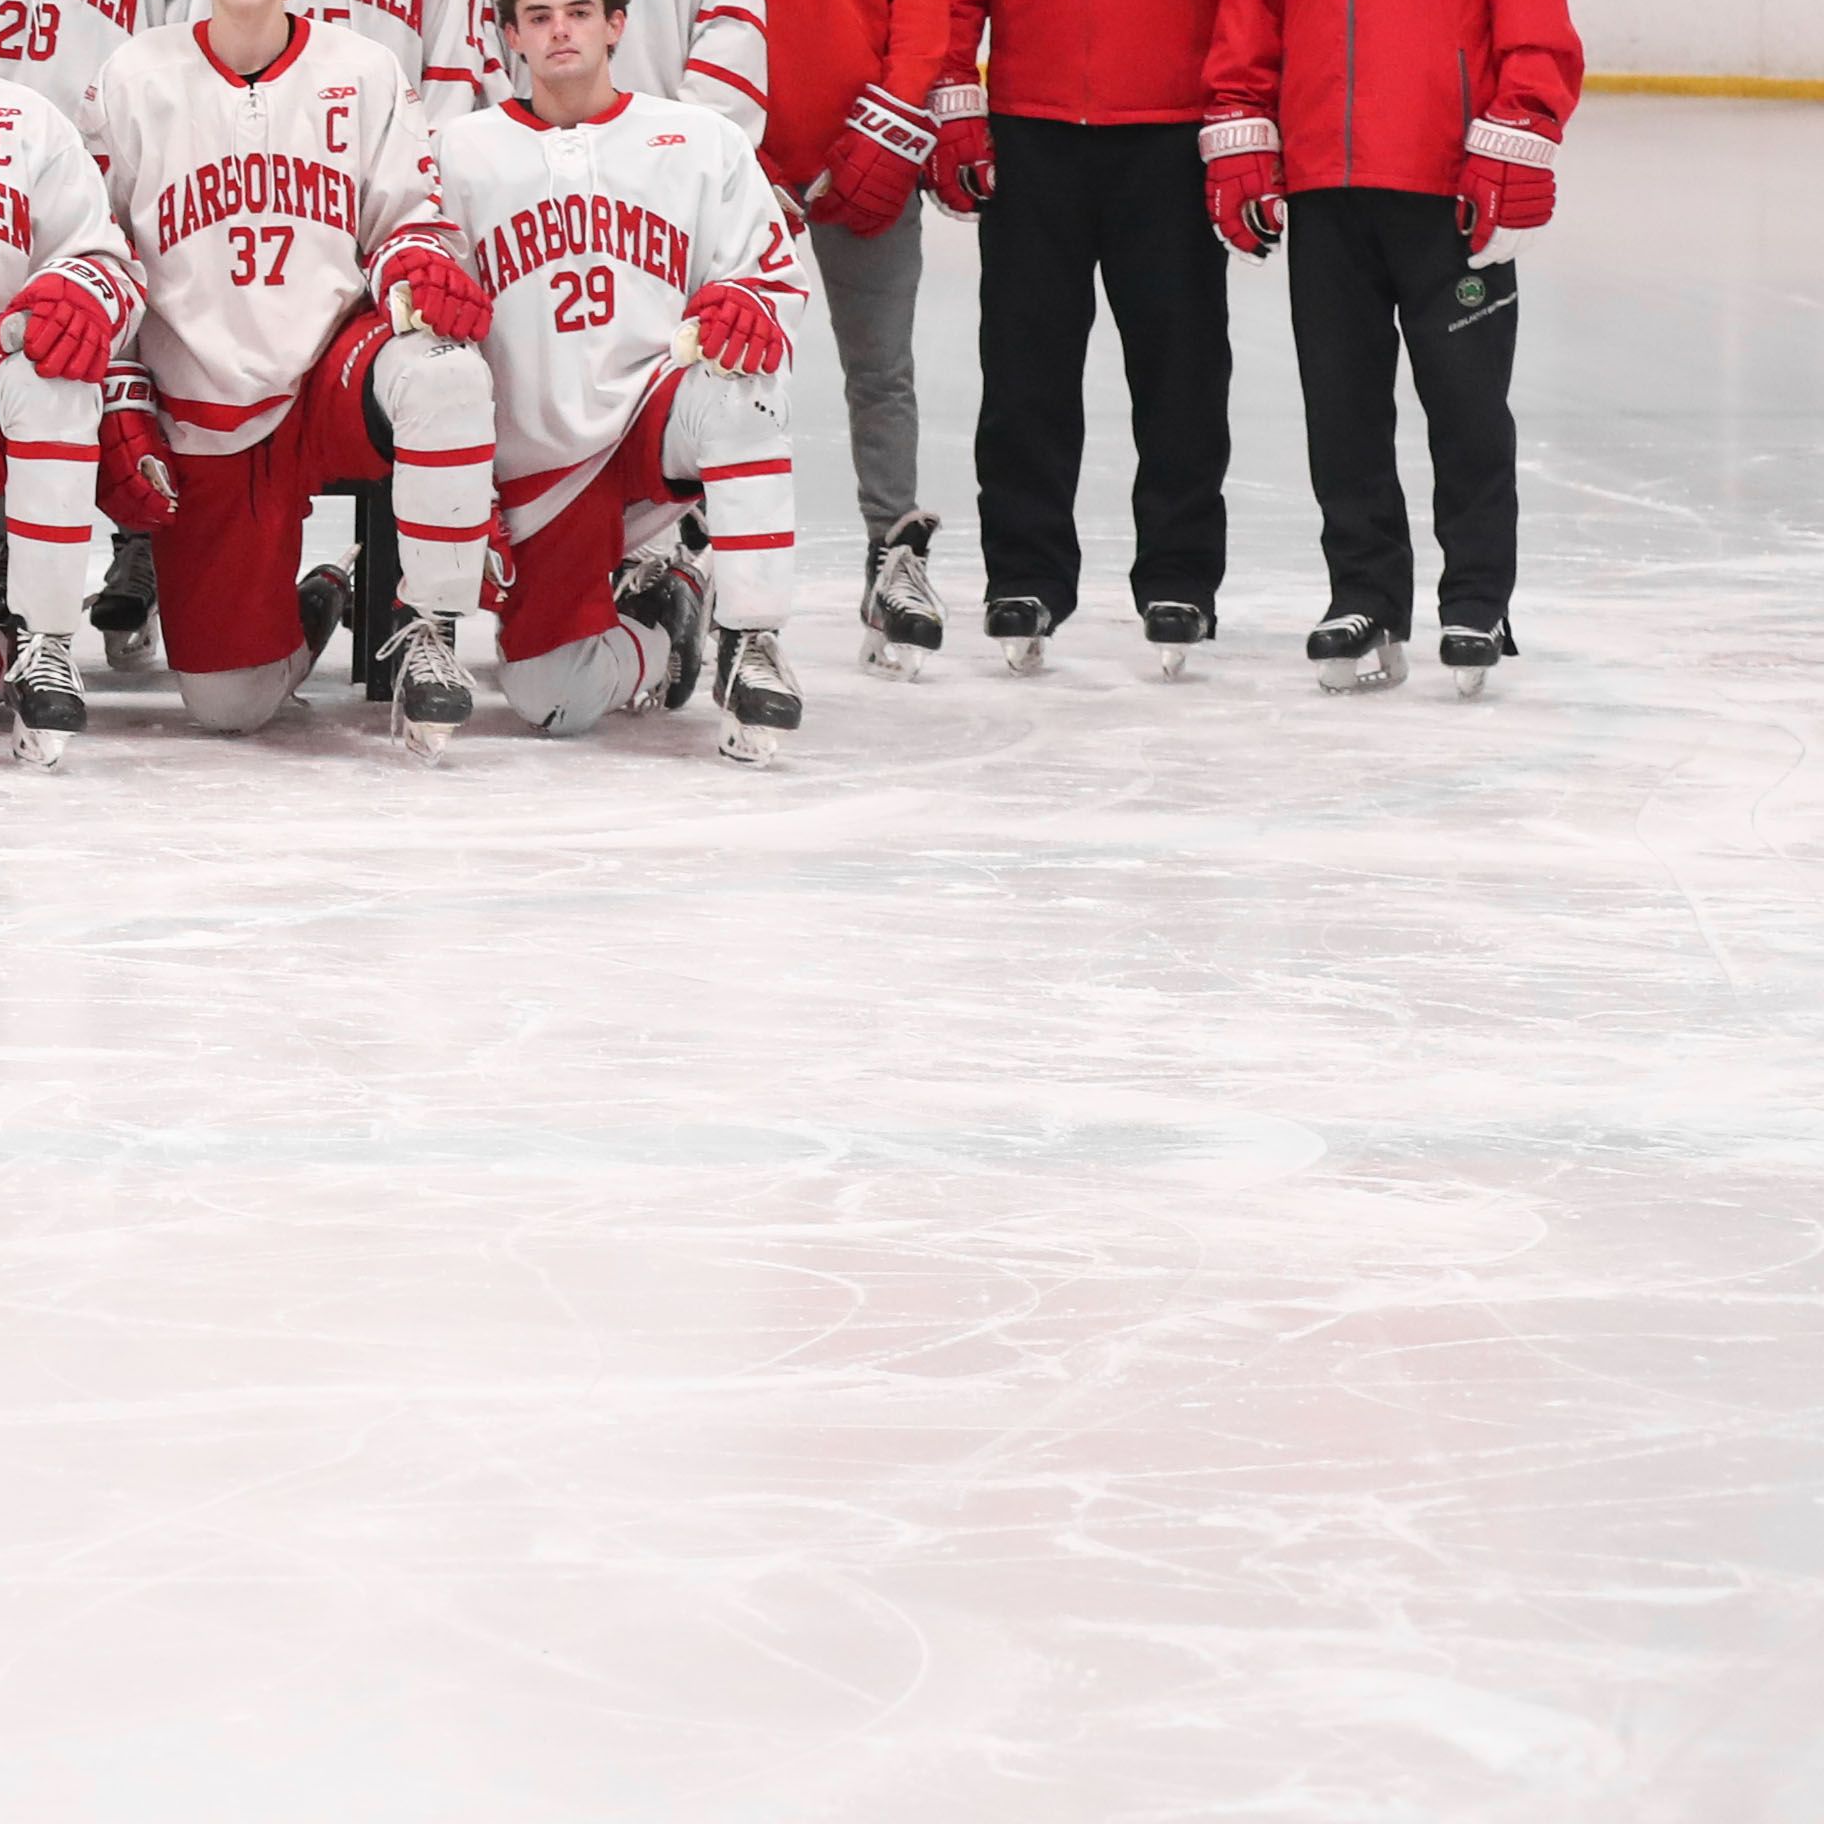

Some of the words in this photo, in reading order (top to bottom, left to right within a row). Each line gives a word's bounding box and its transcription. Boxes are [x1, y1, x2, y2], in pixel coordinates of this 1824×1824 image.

[327, 107, 349, 153] C
[230, 226, 294, 286] 37
[476, 194, 689, 300] HARBORMEN
[551, 266, 614, 332] 29
